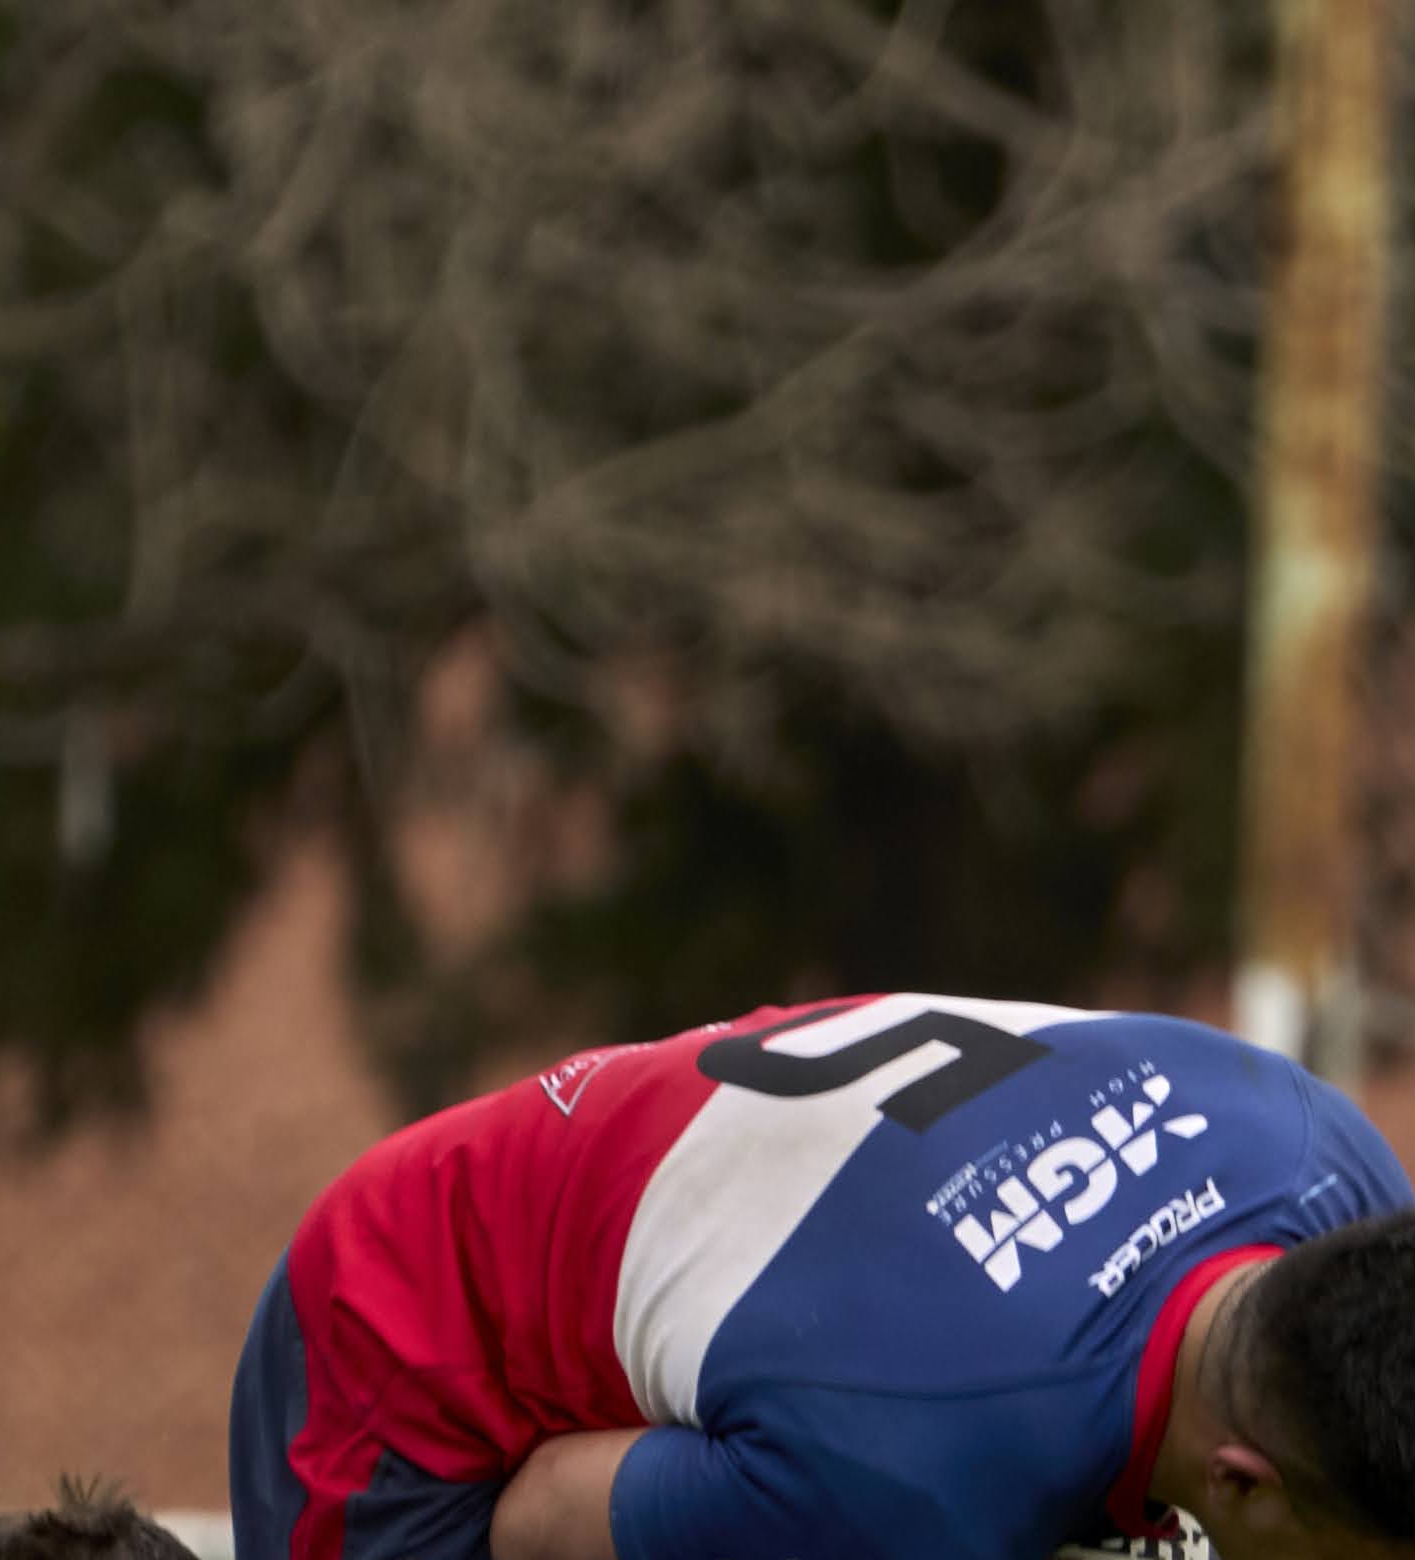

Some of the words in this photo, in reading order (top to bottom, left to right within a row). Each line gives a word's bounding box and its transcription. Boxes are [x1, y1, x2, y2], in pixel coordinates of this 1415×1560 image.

[696, 1003, 1056, 1135] 5
[1089, 1060, 1155, 1108] HIGH
[953, 1074, 1208, 1293] MGM
[1088, 1175, 1226, 1298] PROCER
